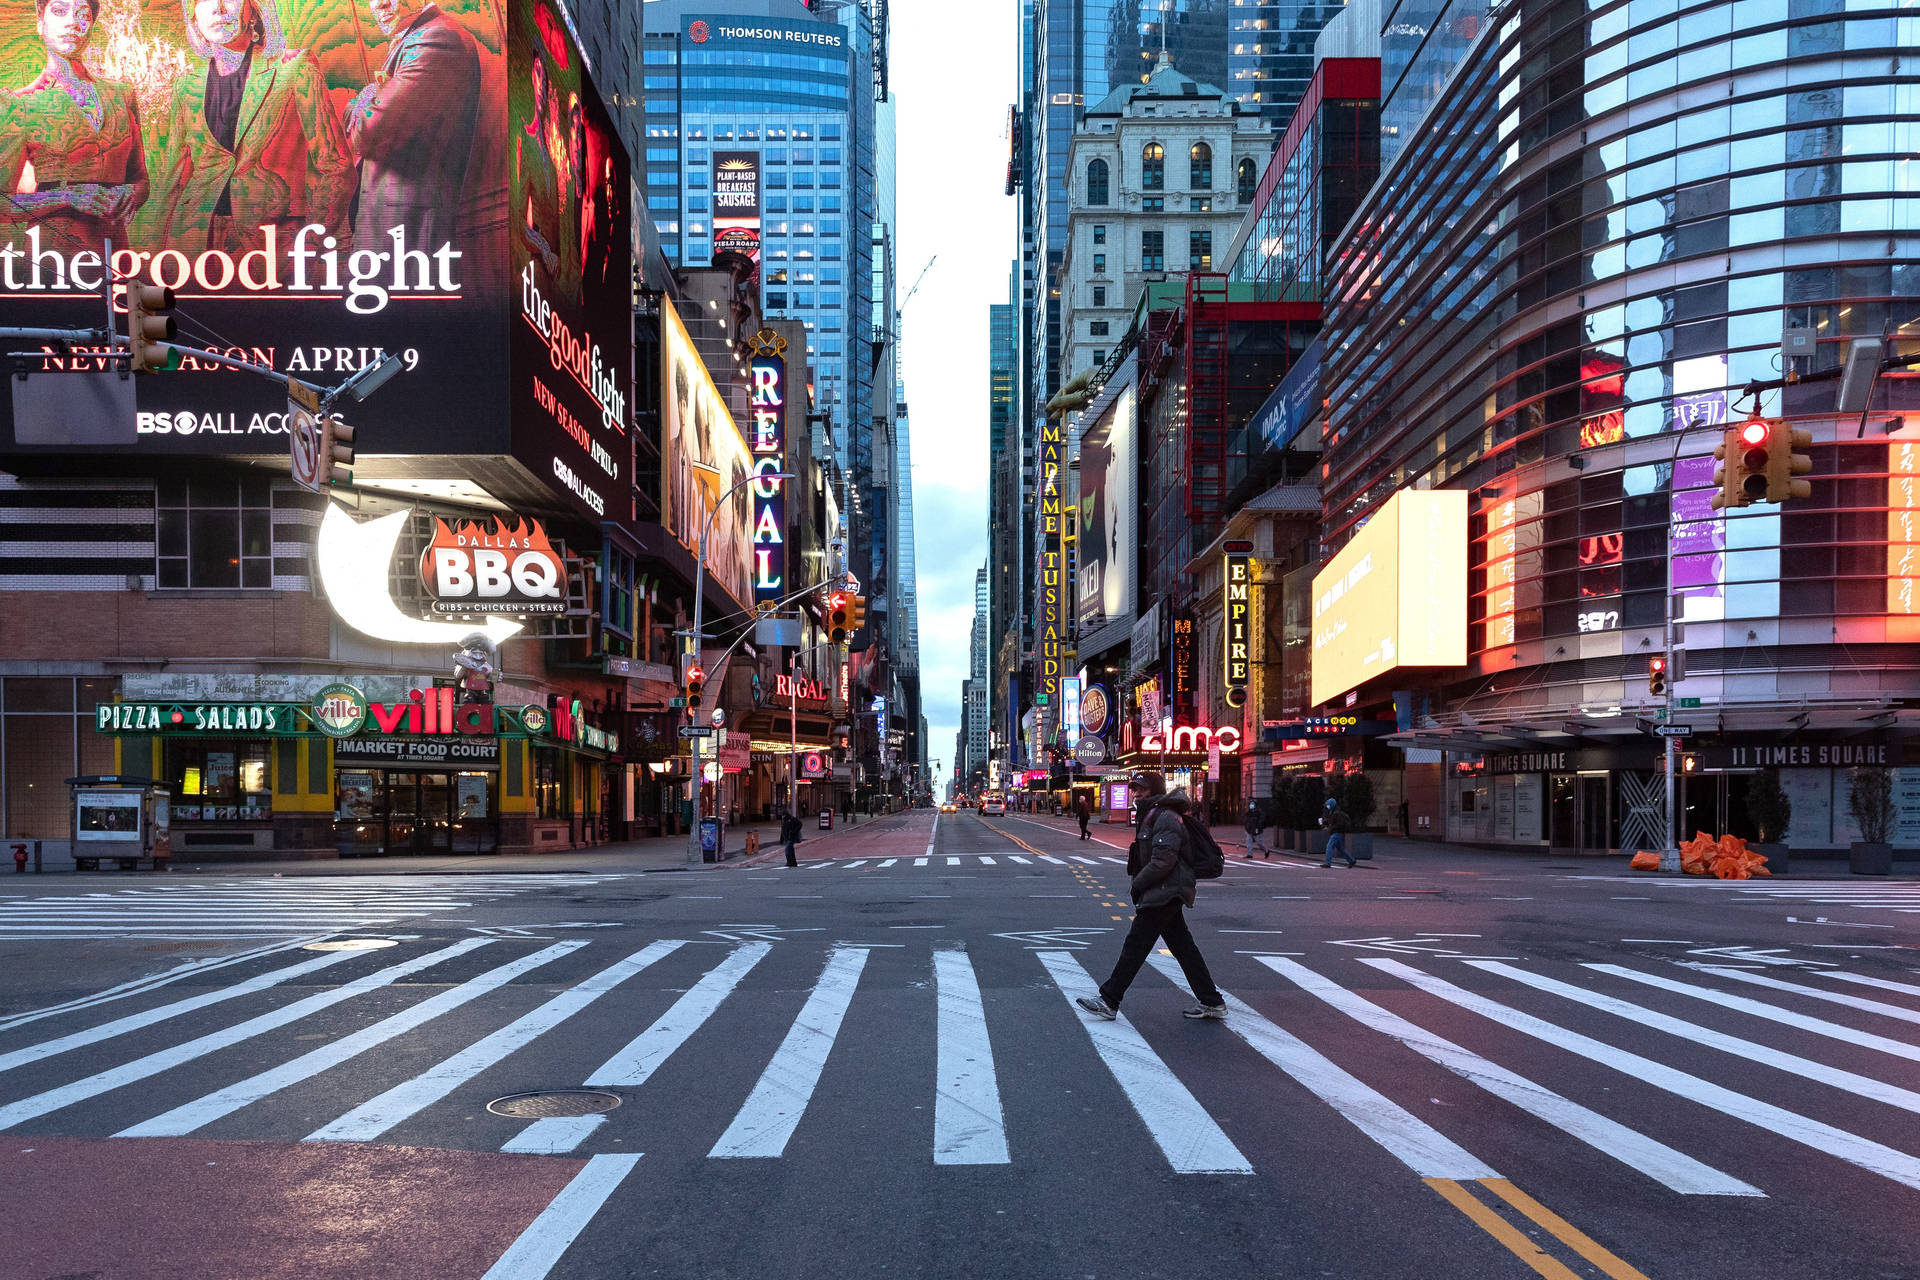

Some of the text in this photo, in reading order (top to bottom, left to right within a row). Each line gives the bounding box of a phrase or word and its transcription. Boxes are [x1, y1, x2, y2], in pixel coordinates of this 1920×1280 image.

[718, 26, 841, 47] THOMSON REUTERS
[717, 171, 756, 181] PLANT-BASED
[717, 182, 755, 192] BREAKFAST
[717, 194, 756, 207] SAUSAGE
[403, 348, 420, 372] 9
[137, 412, 173, 434] BS
[198, 413, 245, 434] ALL
[534, 375, 618, 480] NEW SEASON APRIL 9
[1262, 393, 1287, 441] IMAX
[751, 366, 783, 590] REGAL
[1042, 425, 1060, 533] MADAME
[582, 484, 604, 516] ACCESS
[457, 535, 531, 549] DALLAS
[434, 547, 560, 598] BBQ
[438, 602, 564, 612] RIBS CHICKEN STEAKS
[1043, 552, 1060, 695] TUSSAUD'S
[1229, 564, 1248, 680] EMPIRE
[99, 706, 276, 730] PIZZA SALADS
[314, 699, 362, 719] villa
[369, 687, 494, 735] villa
[522, 712, 547, 724] villa
[343, 741, 404, 754] MARKET
[409, 743, 448, 756] FOOD
[451, 745, 498, 757] COURT
[1078, 749, 1102, 757] Hilton
[1732, 745, 1887, 766] 11 TIMES SQUARE
[1493, 755, 1519, 772] TIMES
[1521, 752, 1566, 772] SQUARE
